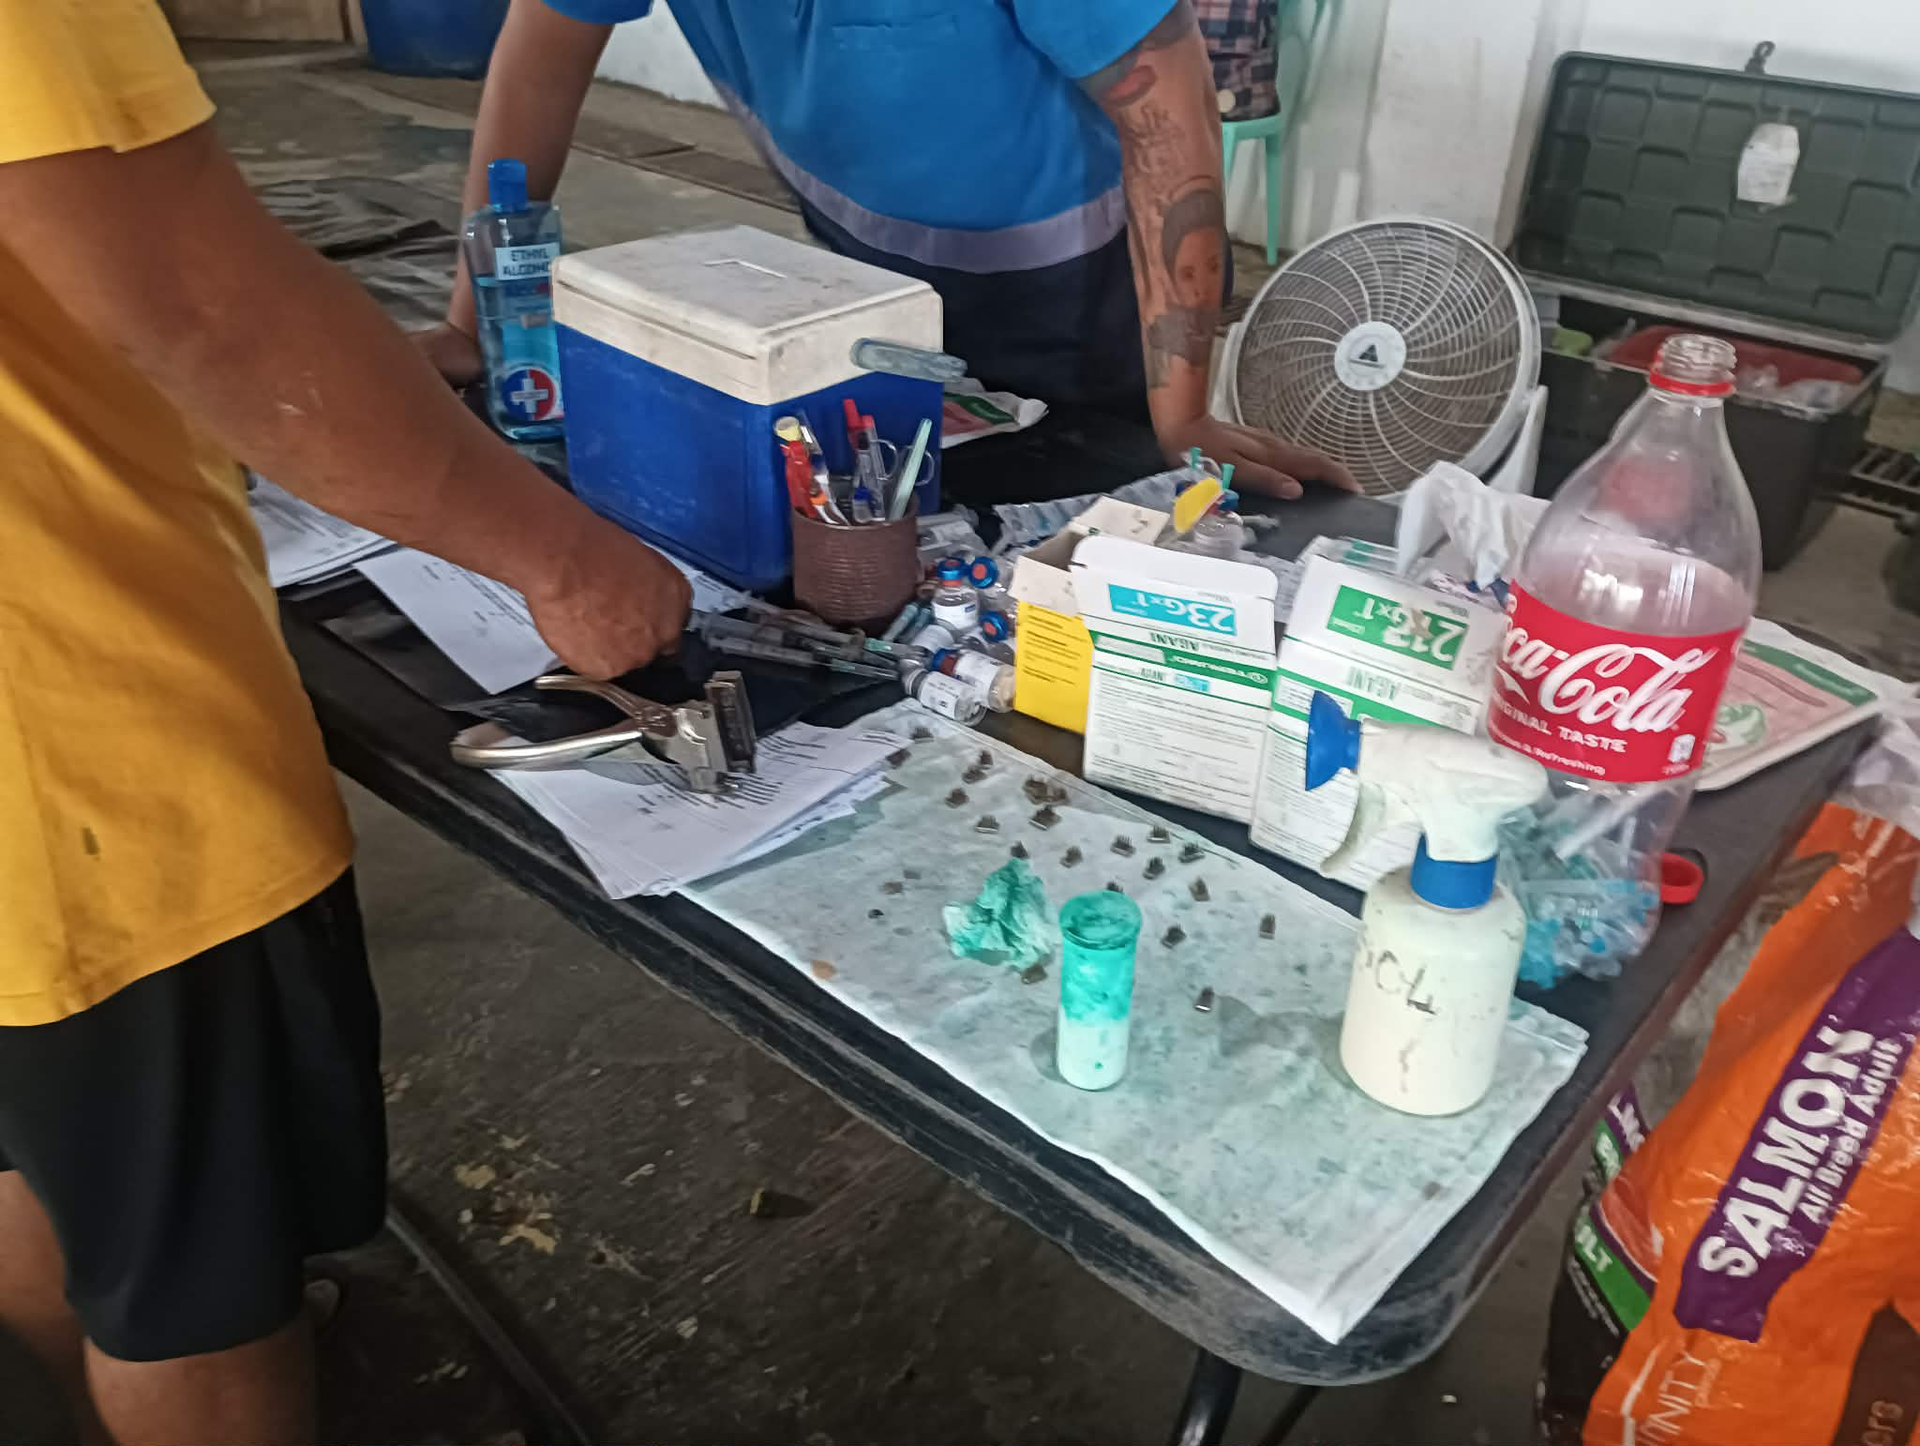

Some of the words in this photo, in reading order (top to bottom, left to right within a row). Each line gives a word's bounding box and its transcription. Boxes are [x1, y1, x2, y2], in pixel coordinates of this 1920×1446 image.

[1557, 725, 1628, 753] TASTE
[1698, 1026, 1875, 1277] SALMON
[1800, 1184, 1833, 1225] All
[1850, 1038, 1903, 1118] Adult
